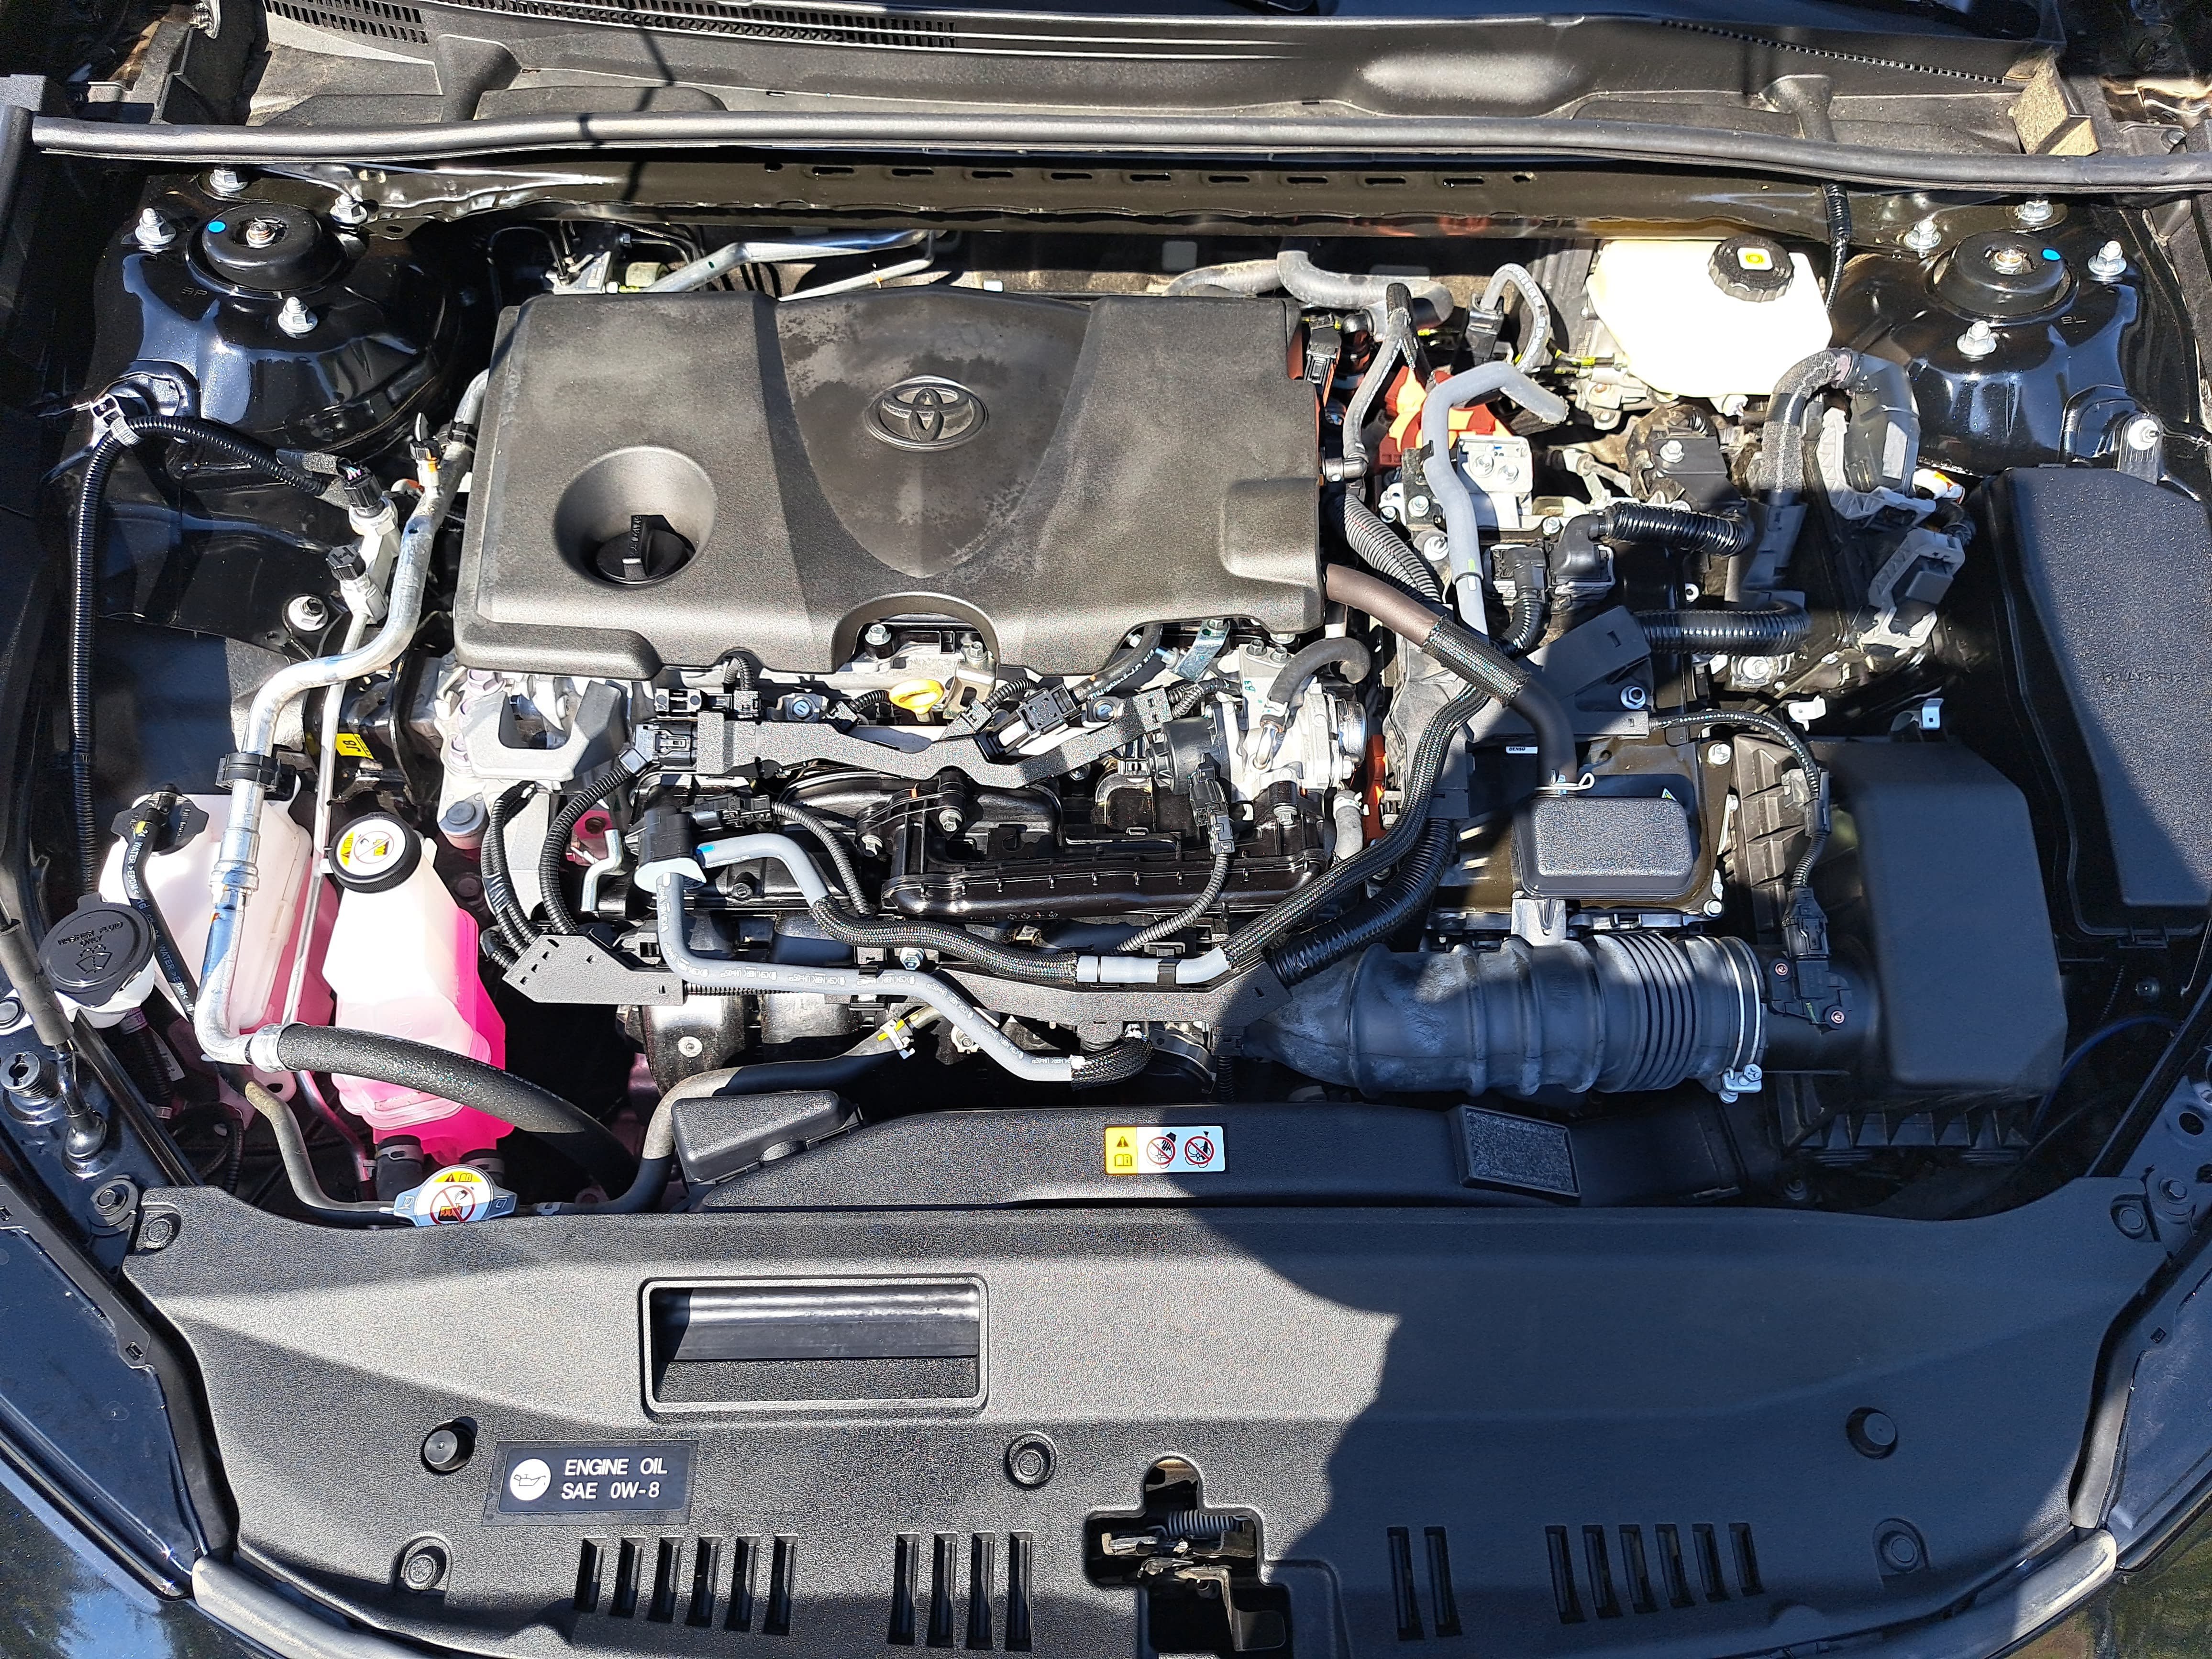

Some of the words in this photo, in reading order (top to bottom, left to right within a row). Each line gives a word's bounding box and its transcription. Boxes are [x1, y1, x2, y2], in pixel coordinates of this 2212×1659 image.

[342, 740, 356, 752] J8
[127, 841, 144, 864] WATER
[158, 943, 175, 971] WATER
[564, 1458, 630, 1476] ENGINE
[640, 1457, 668, 1475] OIL
[561, 1482, 598, 1500] SAE
[610, 1481, 661, 1499] 0W-8
